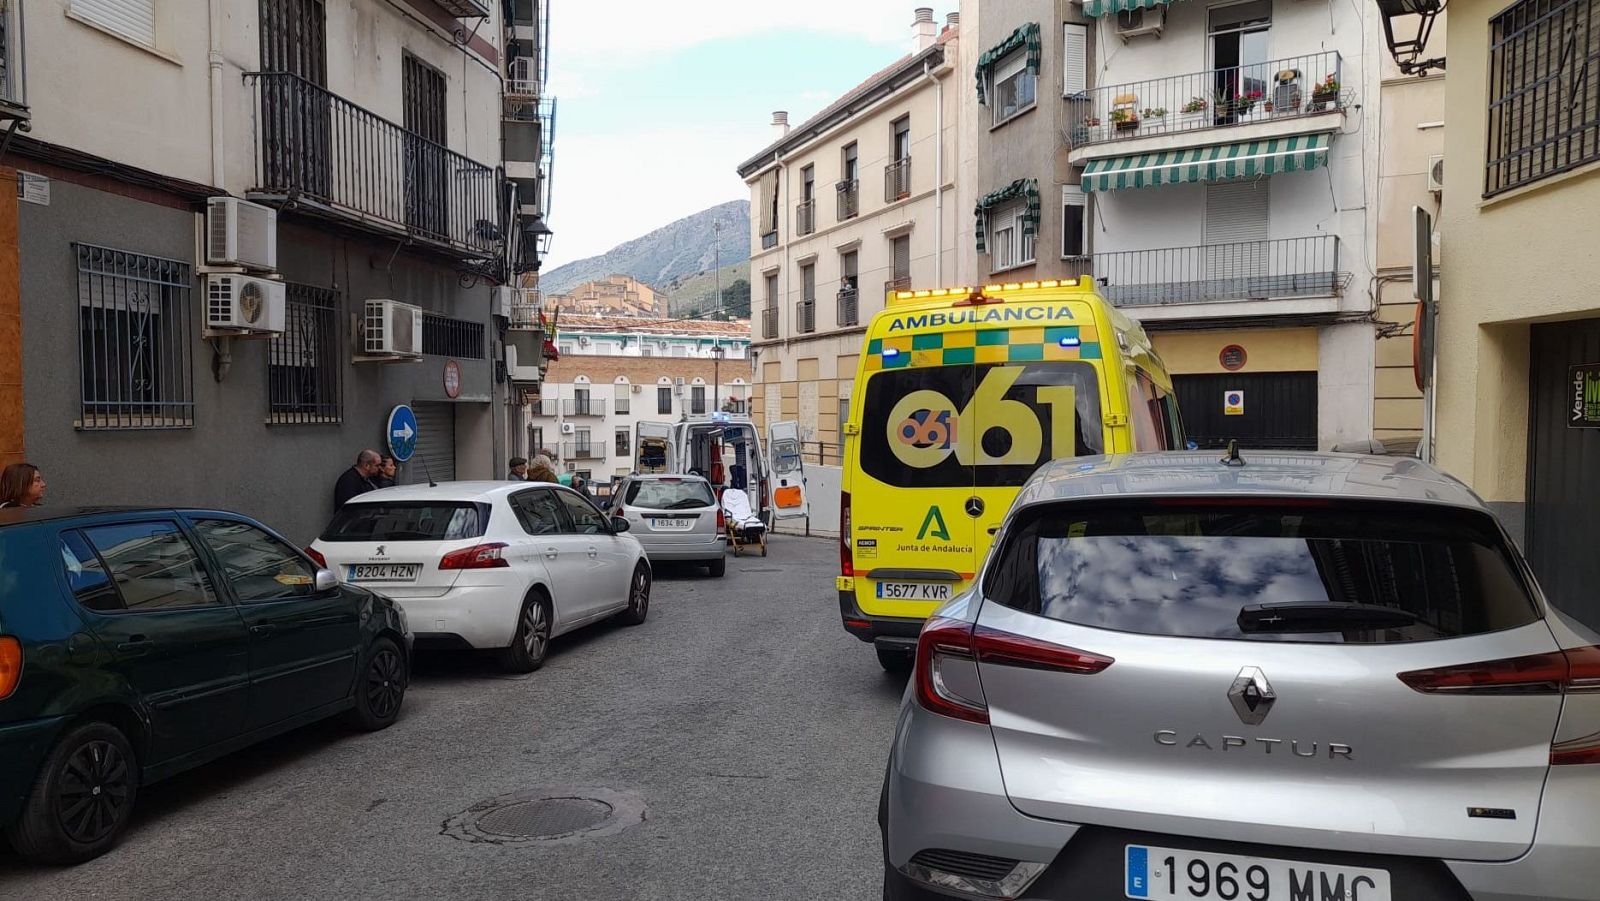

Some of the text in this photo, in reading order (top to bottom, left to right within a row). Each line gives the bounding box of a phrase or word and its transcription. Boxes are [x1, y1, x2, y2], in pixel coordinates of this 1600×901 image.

[889, 306, 1075, 332] AMBULANCIA
[1572, 371, 1583, 421] Vende
[886, 366, 1076, 469] 061
[897, 410, 958, 446] 061
[896, 544, 919, 552] Junta
[920, 544, 930, 552] de
[356, 565, 414, 578] 8204 HZN
[885, 583, 948, 599] 5677 KVR
[1153, 729, 1355, 761] CAPTUR
[1133, 877, 1142, 888] E
[1164, 856, 1270, 901] 1969
